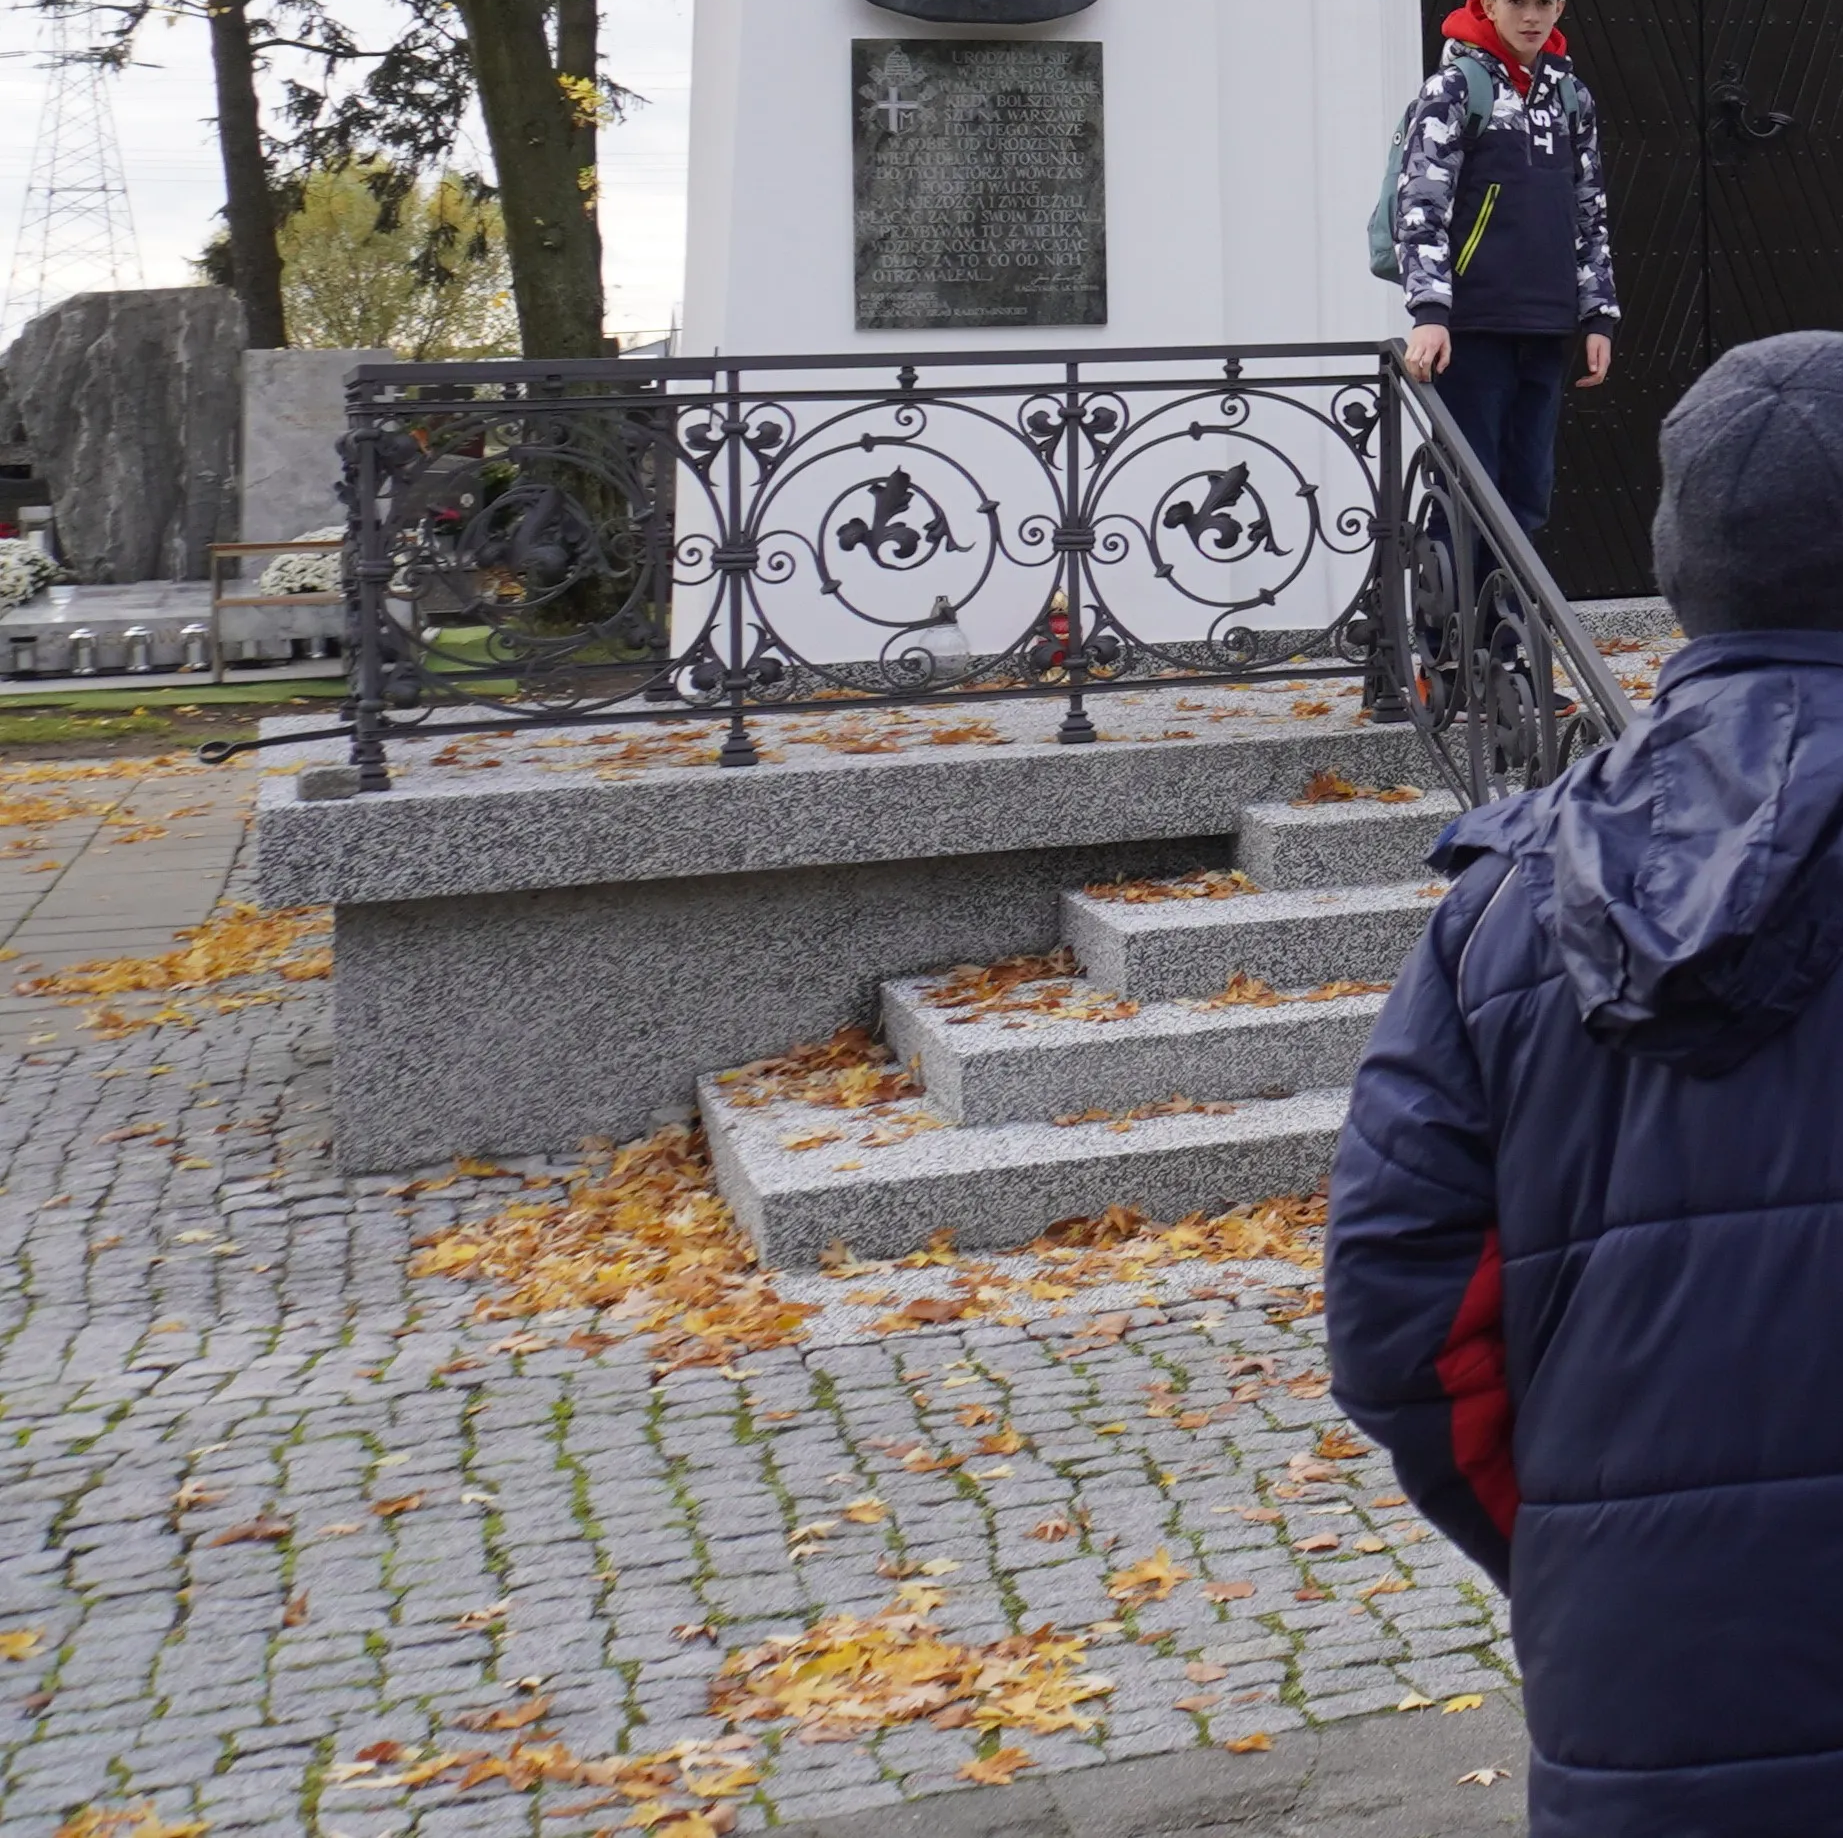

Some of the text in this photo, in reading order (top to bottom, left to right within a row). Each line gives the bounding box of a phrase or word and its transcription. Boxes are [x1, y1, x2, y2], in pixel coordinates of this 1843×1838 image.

[957, 66, 968, 79] W
[1029, 66, 1066, 79] 1920
[1000, 80, 1014, 93] W
[1018, 80, 1047, 93] TYM
[946, 94, 989, 107] KIEDY
[978, 109, 1003, 122] NA
[954, 123, 1028, 136] DLATEGO
[887, 137, 1076, 150] W SOBIE OD URODZENIA
[983, 152, 996, 165] W
[1001, 152, 1084, 165] STOSUNKU
[876, 165, 901, 179] DO
[928, 210, 949, 223] ZA
[952, 210, 976, 223] TO
[982, 210, 1027, 223] SWOIM
[880, 224, 975, 238] PRZYBYWAM
[982, 224, 1003, 238] TU
[1008, 224, 1019, 238] Z
[932, 253, 953, 267] ZA
[958, 253, 979, 267] TO
[988, 253, 1009, 267] CO
[1016, 253, 1039, 267] OD
[1044, 253, 1082, 267] NICH
